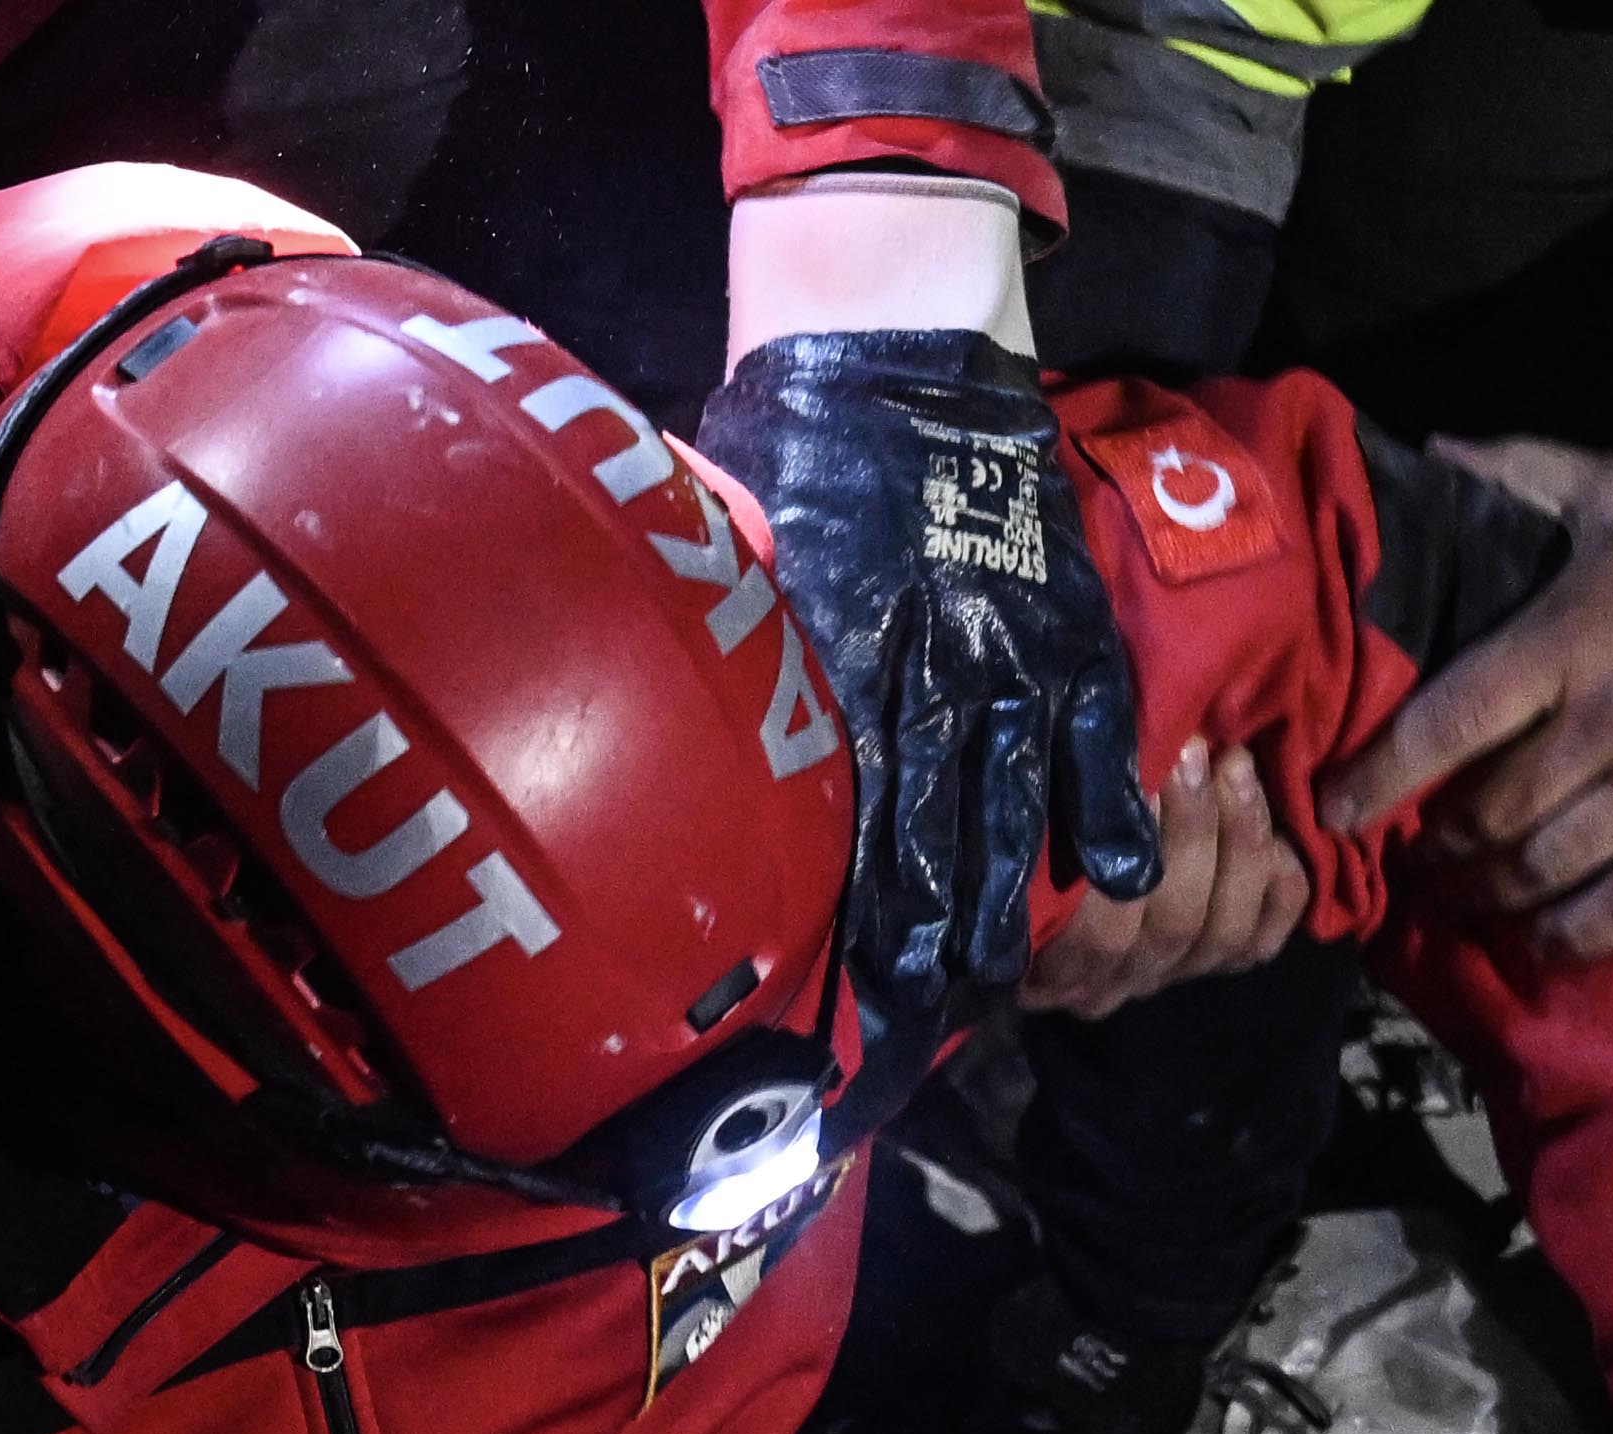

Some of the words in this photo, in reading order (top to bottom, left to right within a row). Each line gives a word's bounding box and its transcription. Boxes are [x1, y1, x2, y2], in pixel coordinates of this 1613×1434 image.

[55, 479, 563, 994] AKUT
[400, 312, 842, 783] AKUT
[923, 524, 1049, 586] STARLINE
